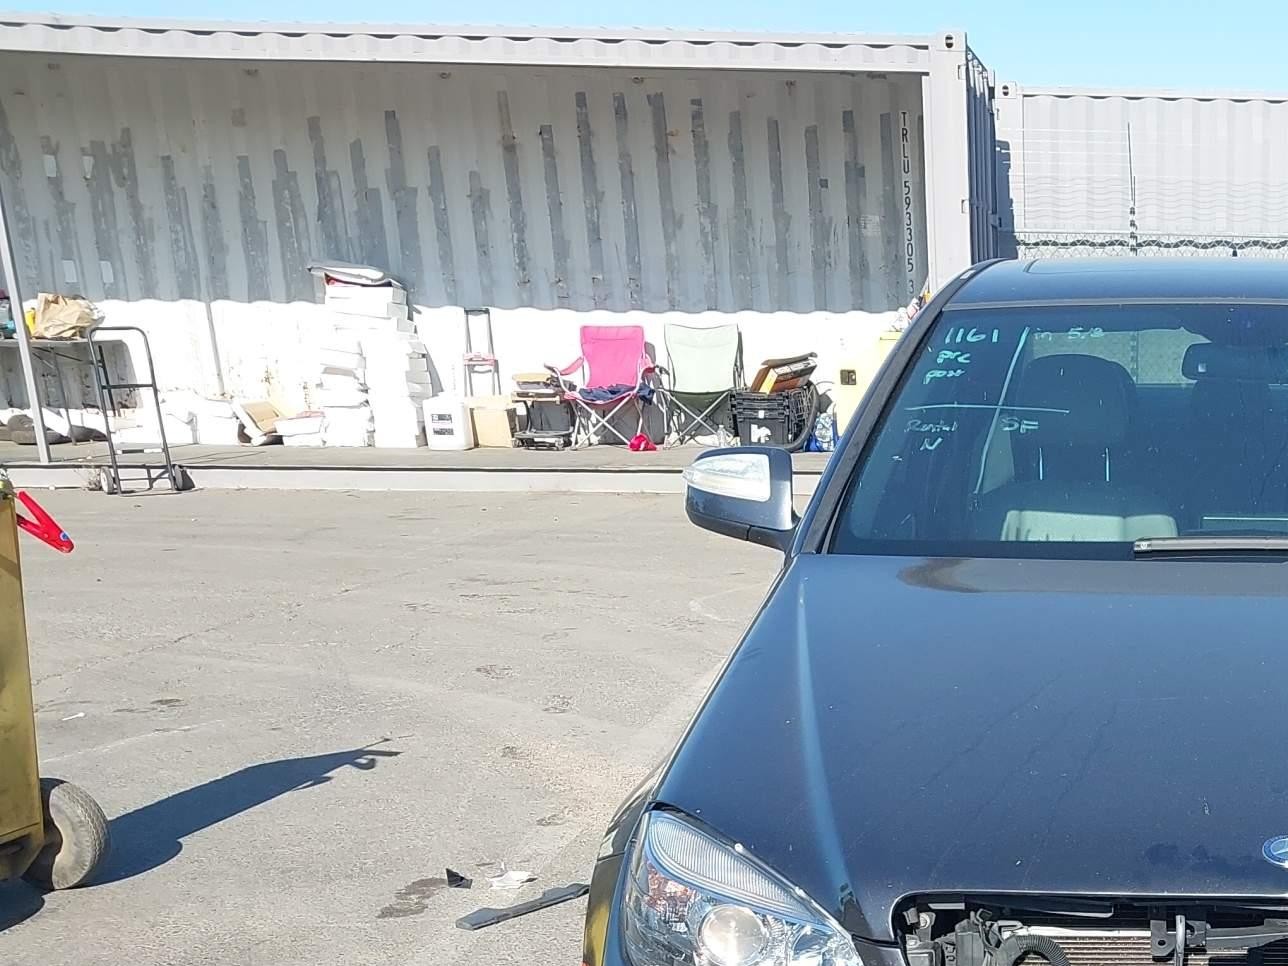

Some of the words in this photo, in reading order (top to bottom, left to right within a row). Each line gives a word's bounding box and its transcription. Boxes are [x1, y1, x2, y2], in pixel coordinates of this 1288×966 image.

[900, 111, 911, 174] TRLU
[903, 180, 915, 273] 593305
[908, 279, 915, 295] 3
[944, 327, 1000, 345] 1161
